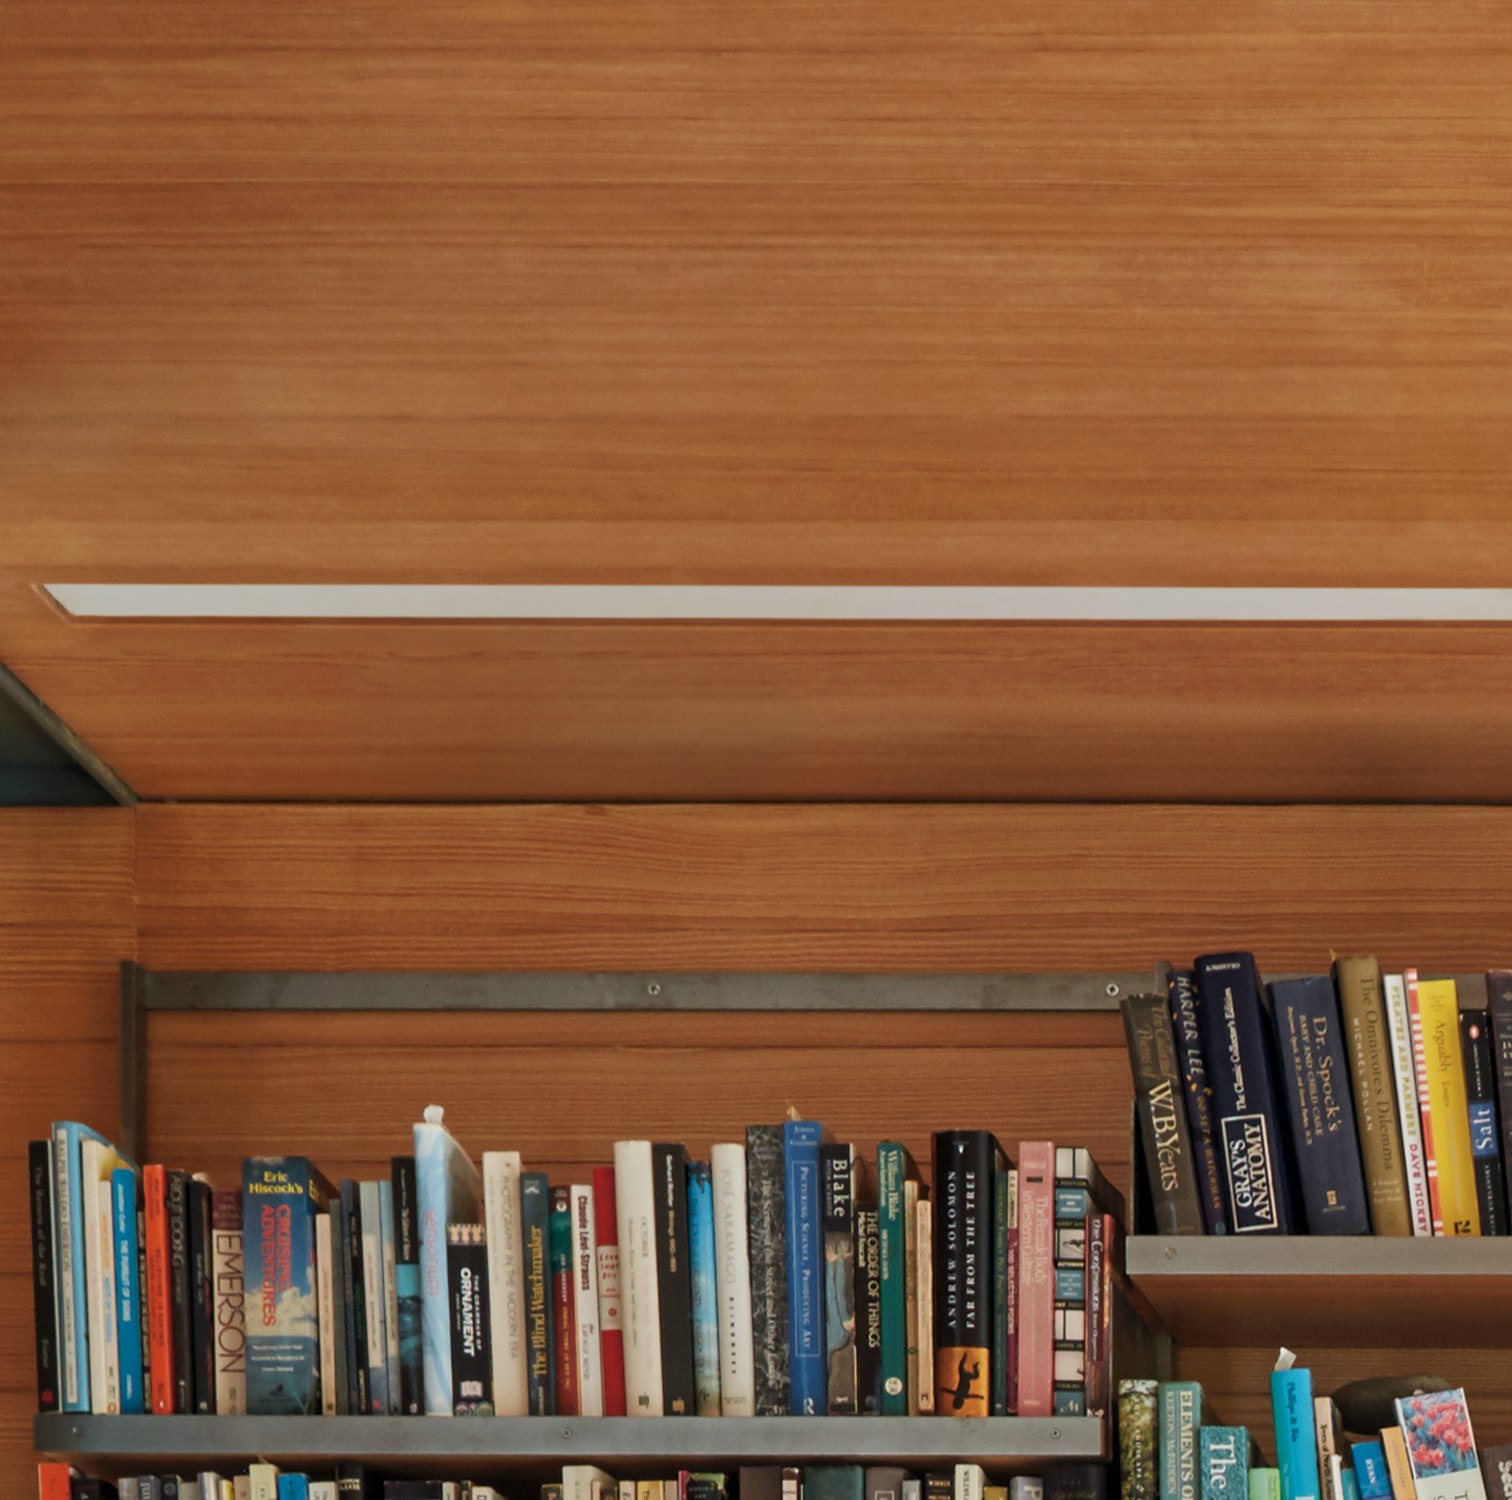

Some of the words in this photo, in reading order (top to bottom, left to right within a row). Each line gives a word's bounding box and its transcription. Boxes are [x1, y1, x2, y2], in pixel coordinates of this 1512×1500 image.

[1312, 1016, 1329, 1048] Dr.
[1315, 1056, 1340, 1131] Spock's
[833, 1159, 848, 1217] Blake
[262, 1204, 277, 1326] ADVENTURES
[277, 1205, 291, 1291] CRUISING
[215, 1233, 244, 1373] EMERSON
[461, 1268, 475, 1357] ORNAMENT
[1209, 1437, 1236, 1488] The
